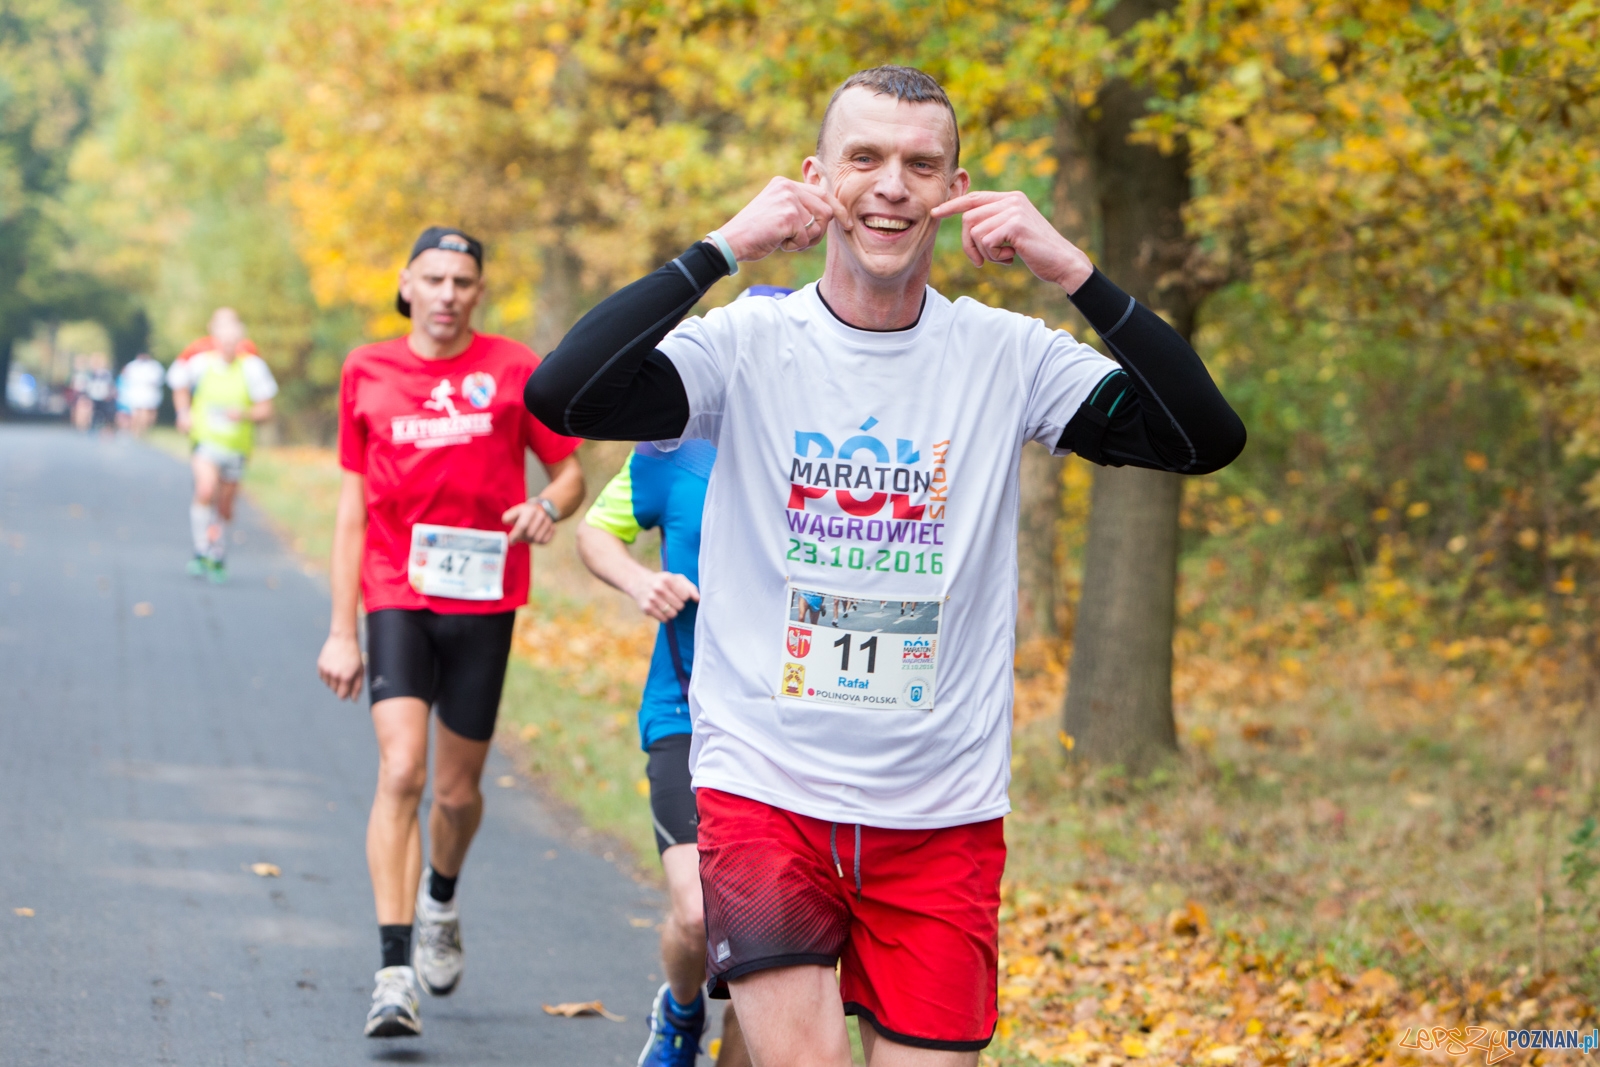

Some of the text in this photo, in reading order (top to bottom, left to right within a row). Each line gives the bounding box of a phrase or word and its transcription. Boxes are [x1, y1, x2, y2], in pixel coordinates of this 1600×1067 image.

[790, 457, 931, 493] MARATON
[929, 440, 950, 519] SKOKI
[785, 510, 945, 546] WĄGROWIEC
[438, 552, 471, 575] 47
[786, 538, 943, 575] 23.10.2016
[833, 633, 878, 674] 11
[816, 690, 861, 703] POLINOVA
[863, 695, 897, 705] POLSKA
[837, 676, 870, 690] Rafał
